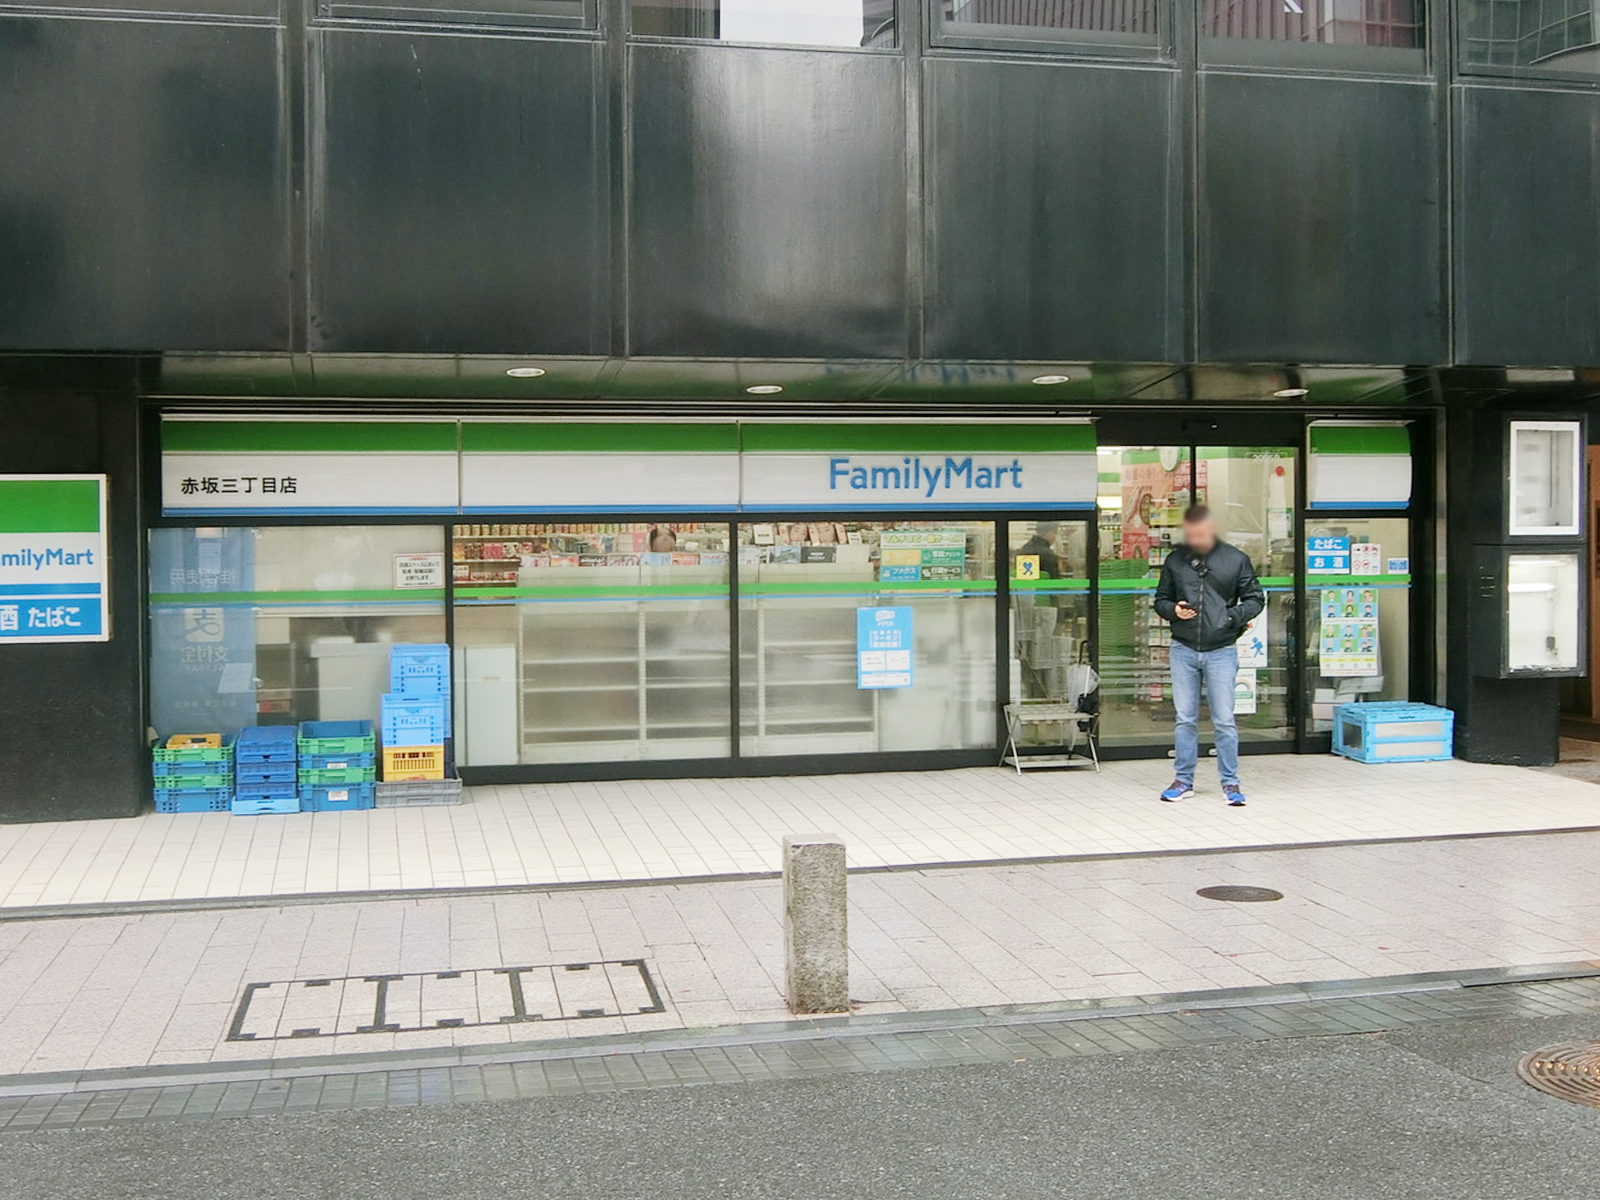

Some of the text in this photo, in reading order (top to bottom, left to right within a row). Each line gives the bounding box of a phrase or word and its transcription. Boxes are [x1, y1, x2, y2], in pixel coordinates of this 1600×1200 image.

[181, 476, 298, 495] 赤坂三丁目店
[830, 458, 1022, 497] FamilyMart
[1314, 538, 1343, 550] たばこ
[28, 606, 81, 628] たばこ
